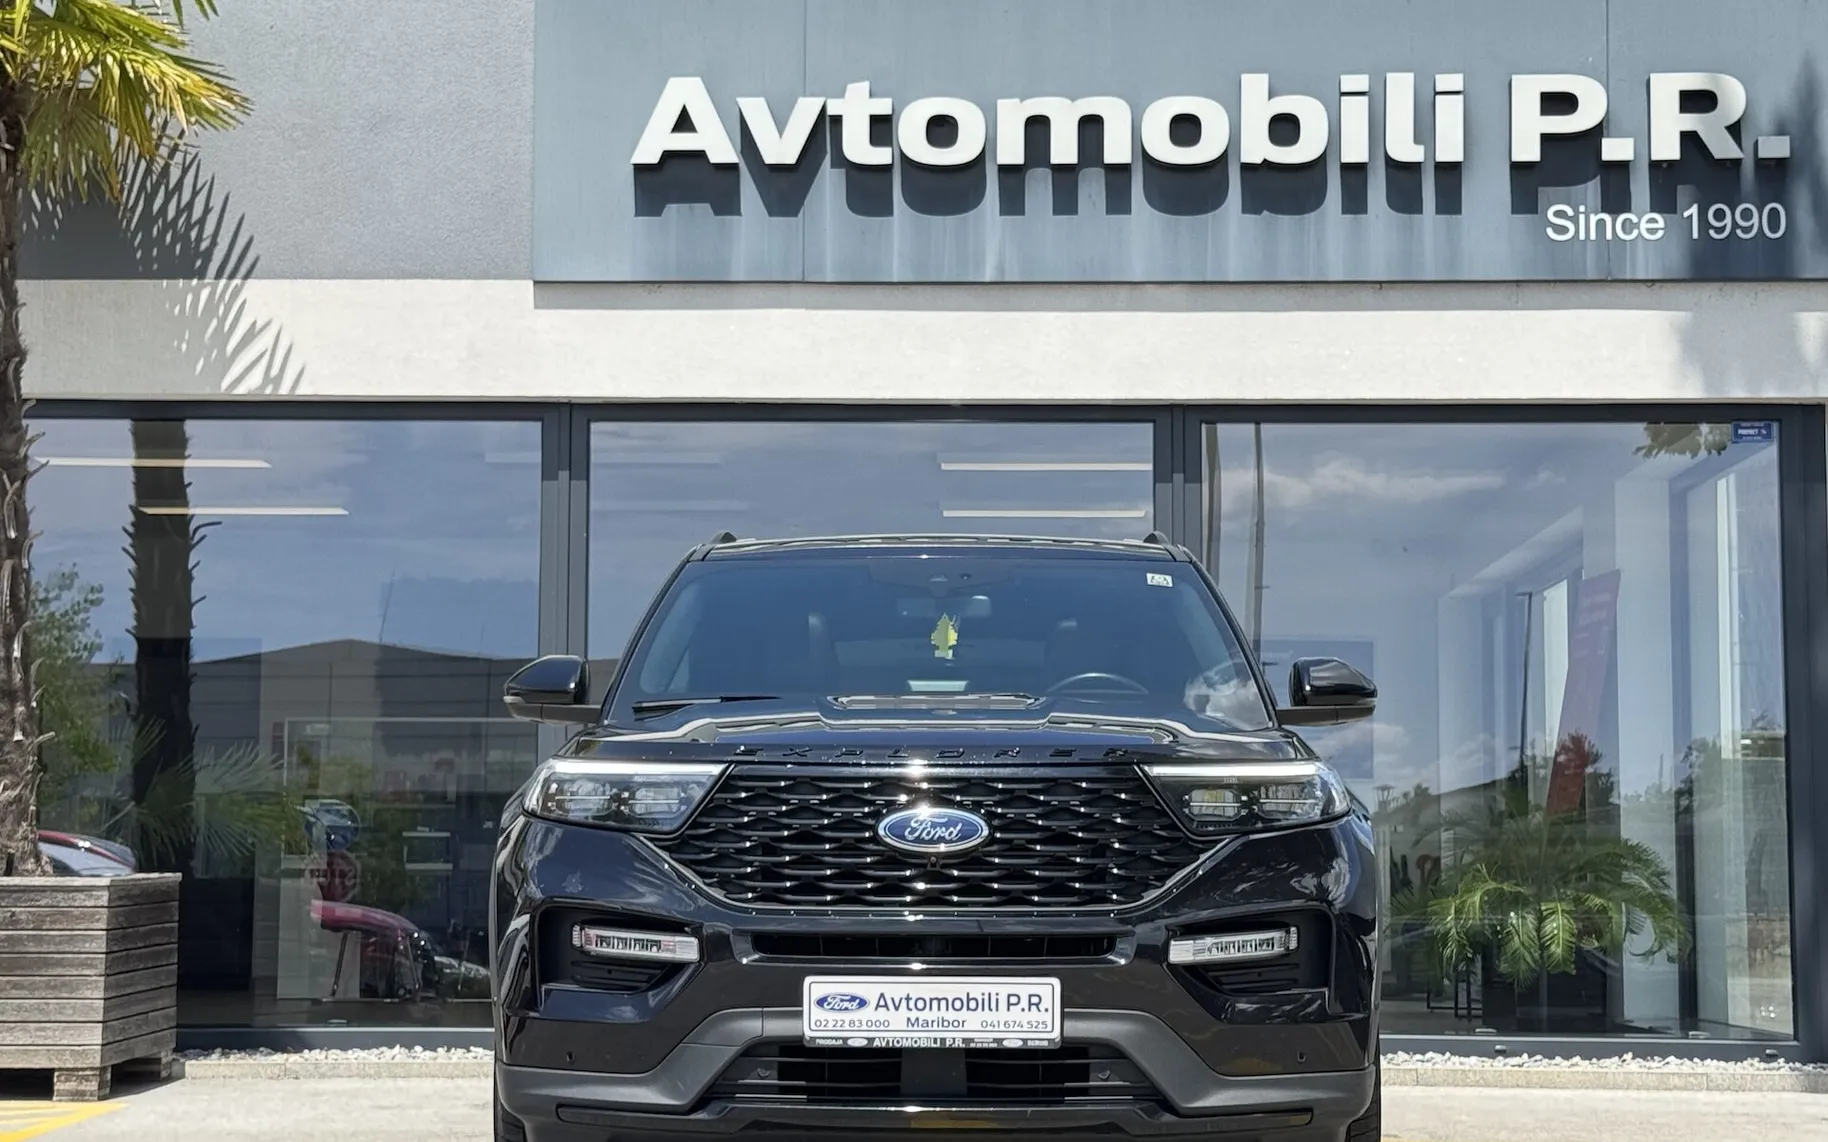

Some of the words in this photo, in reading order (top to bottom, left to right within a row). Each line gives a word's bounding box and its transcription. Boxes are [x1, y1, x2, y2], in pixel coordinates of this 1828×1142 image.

[630, 72, 1464, 166] Avtomobili
[1511, 72, 1791, 162] P.R.
[1545, 203, 1666, 242] Since
[1682, 202, 1787, 240] 1990
[904, 815, 962, 841] Ford
[823, 994, 860, 1011] Ford
[874, 992, 999, 1012] Avtomobili
[1006, 993, 1049, 1013] P.R.
[865, 1019, 890, 1028] 000
[906, 1016, 967, 1029] Maribor
[981, 1019, 1001, 1029] 041
[1003, 1019, 1024, 1029] 674
[1026, 1020, 1049, 1030] 525
[873, 1037, 941, 1048] AVTOMOBILI
[945, 1038, 966, 1048] P.R.
